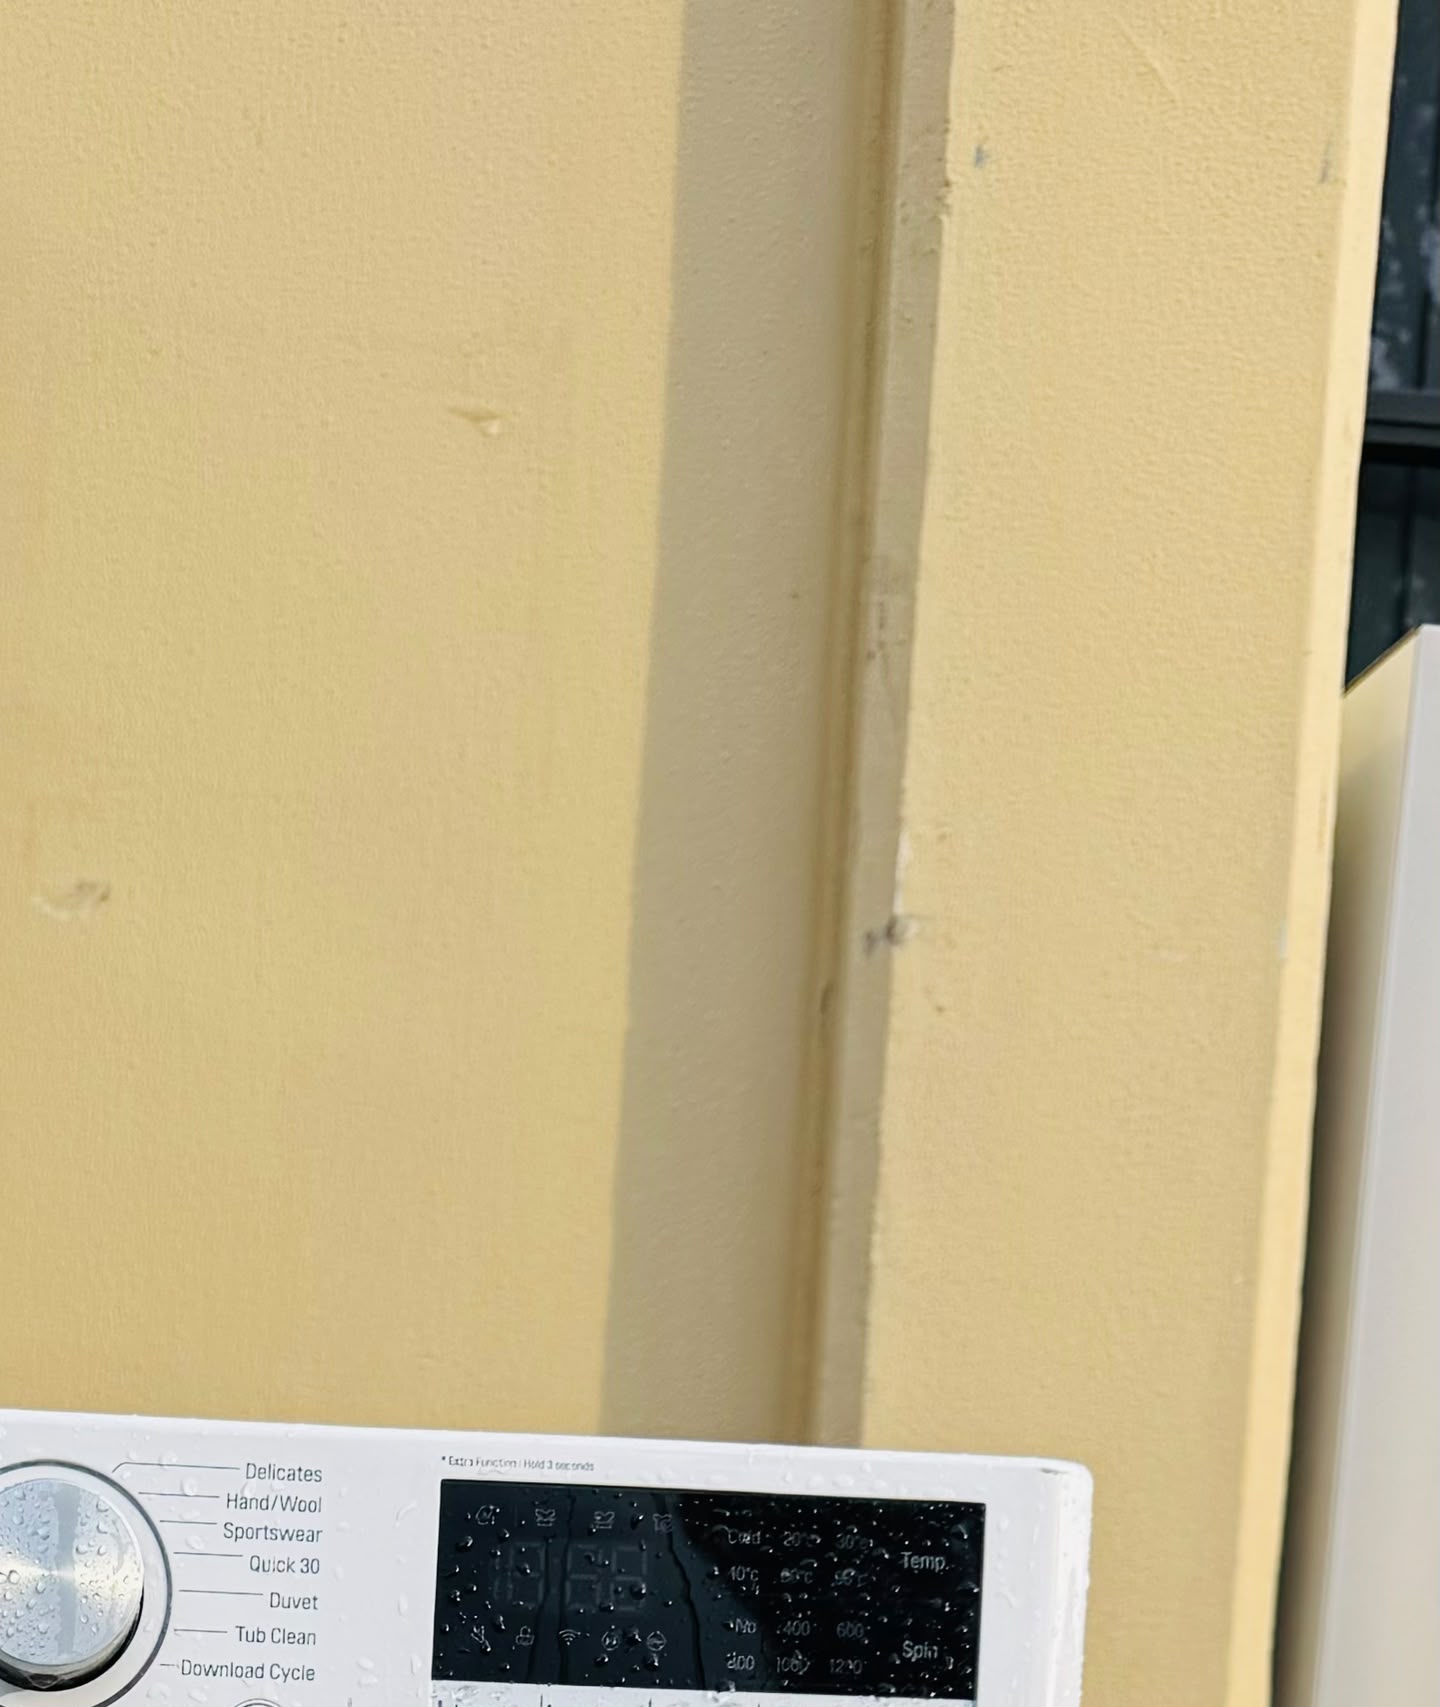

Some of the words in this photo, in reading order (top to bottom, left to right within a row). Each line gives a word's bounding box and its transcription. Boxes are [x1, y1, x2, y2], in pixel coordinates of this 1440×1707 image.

[246, 1462, 323, 1482] Delicates
[226, 1492, 322, 1513] Hand/Wool
[223, 1521, 323, 1542] Sportswear
[249, 1554, 296, 1573] Quick
[299, 1557, 321, 1575] 30
[269, 1591, 319, 1610] Duvet
[234, 1625, 266, 1643] Tub
[270, 1627, 317, 1645] Clean
[901, 1640, 938, 1661] Spin
[181, 1658, 265, 1679] Download
[269, 1663, 316, 1683] Cycle
